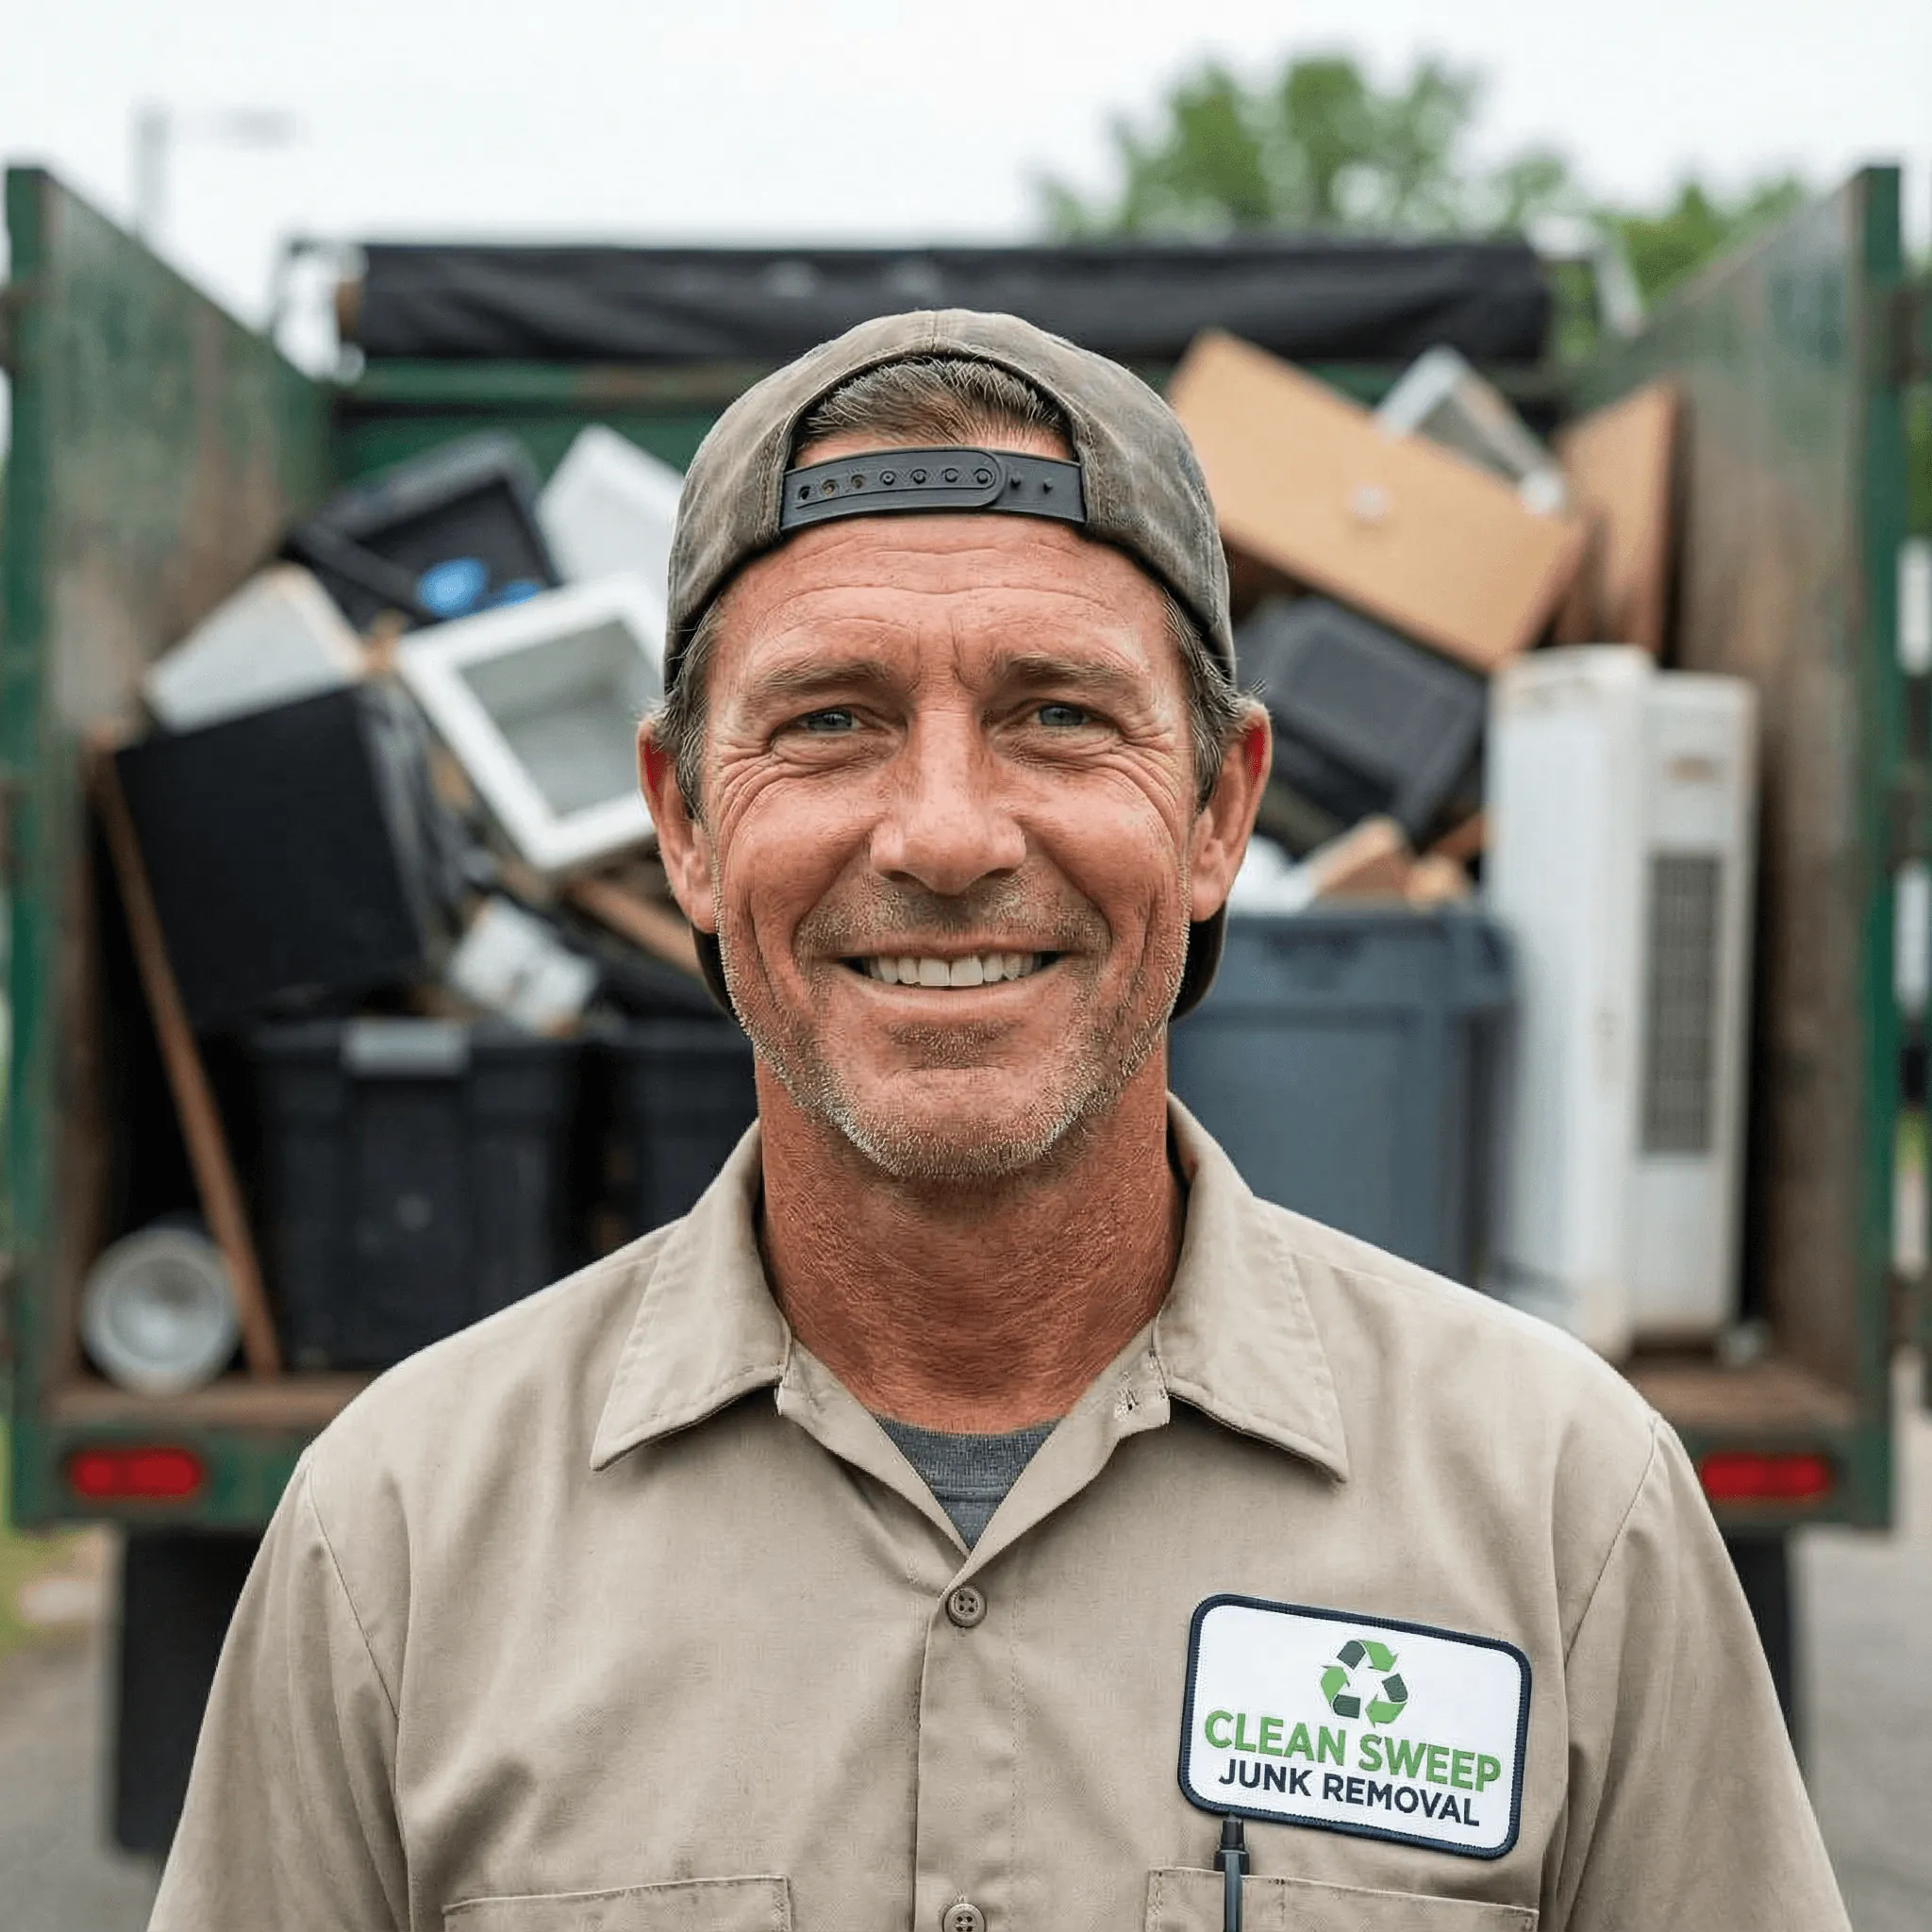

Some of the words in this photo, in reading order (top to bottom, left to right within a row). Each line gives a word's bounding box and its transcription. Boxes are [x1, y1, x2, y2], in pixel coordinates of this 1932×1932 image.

[1205, 1709, 1346, 1766] CLEAN
[1358, 1734, 1501, 1791] SWEEP
[1219, 1758, 1313, 1796] JUNK
[1323, 1773, 1480, 1826] REMOVAL
